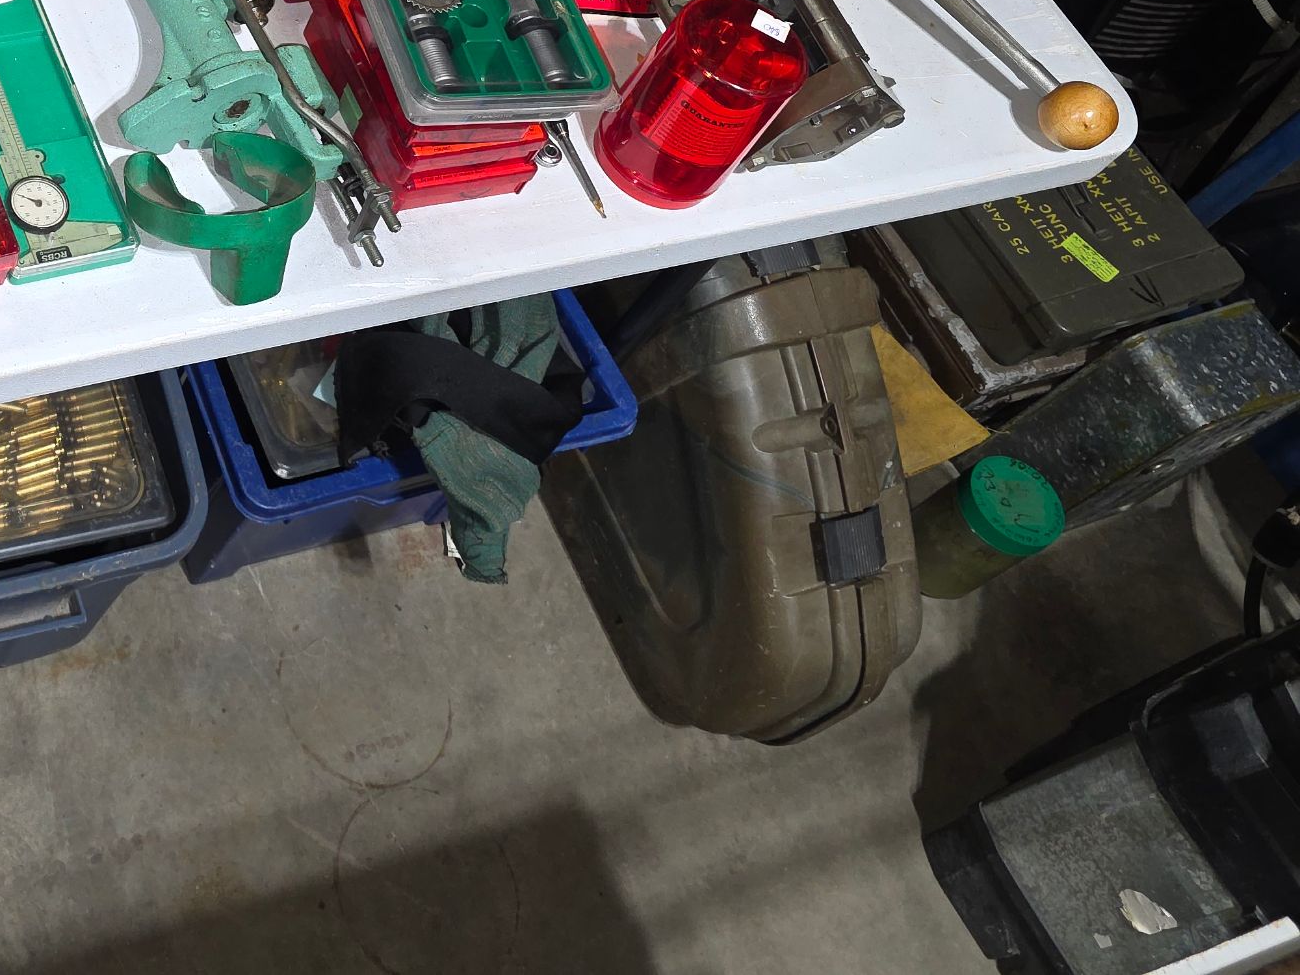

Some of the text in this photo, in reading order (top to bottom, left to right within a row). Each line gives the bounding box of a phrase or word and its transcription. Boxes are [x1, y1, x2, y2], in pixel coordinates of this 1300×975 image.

[1138, 166, 1169, 195] USE
[1039, 203, 1070, 241] FUNC
[1100, 201, 1133, 234] HEIT
[1114, 196, 1148, 226] APIT
[982, 202, 1031, 256] 25 CAR
[1030, 218, 1064, 250] HEIT
[1132, 238, 1145, 247] 3
[1147, 232, 1161, 243] 2
[41, 250, 68, 262] RCBS
[1060, 254, 1074, 264] 3
